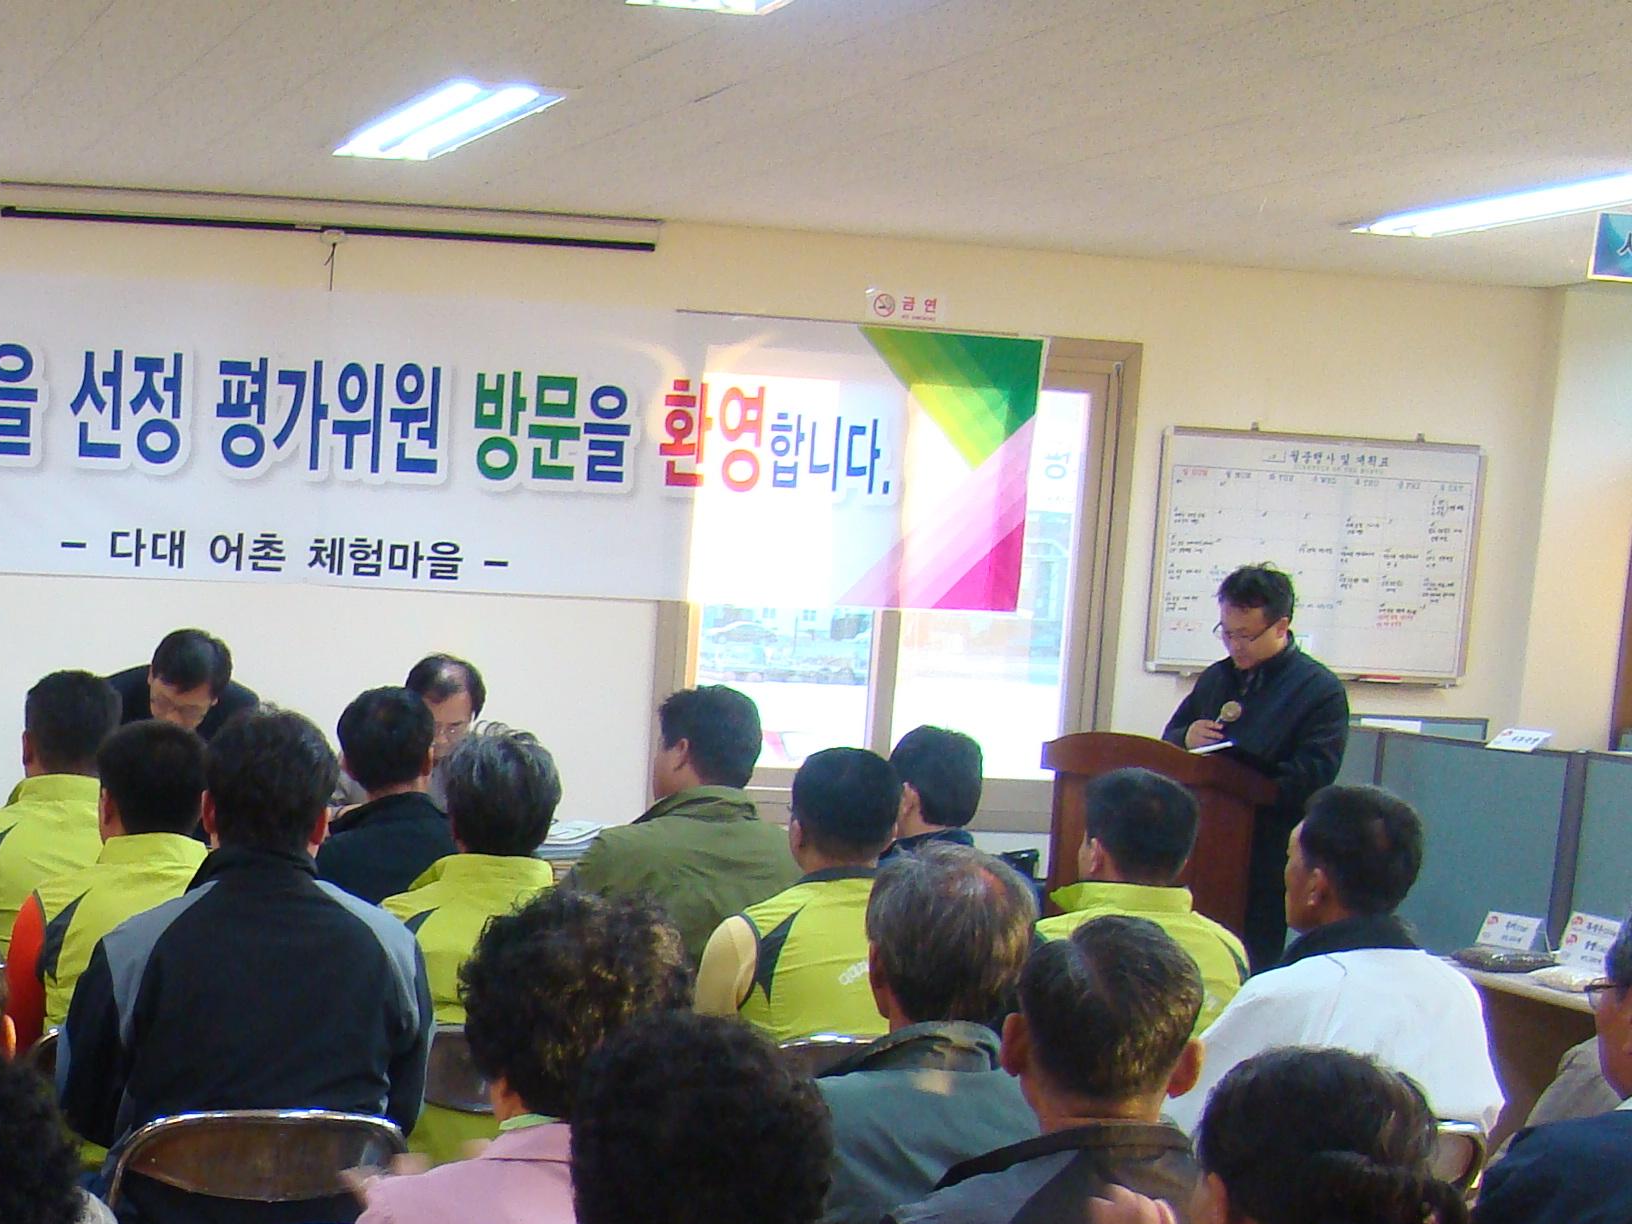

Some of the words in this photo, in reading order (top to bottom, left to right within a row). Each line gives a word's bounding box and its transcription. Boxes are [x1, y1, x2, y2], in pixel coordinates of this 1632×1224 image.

[70, 349, 183, 464] 선정
[216, 357, 441, 474] 평가위원
[474, 371, 631, 483] 방문을
[659, 379, 890, 494] 환영합니다.
[110, 528, 186, 569] 다대
[210, 531, 286, 573] 어촌
[308, 535, 464, 581] 체험마을
